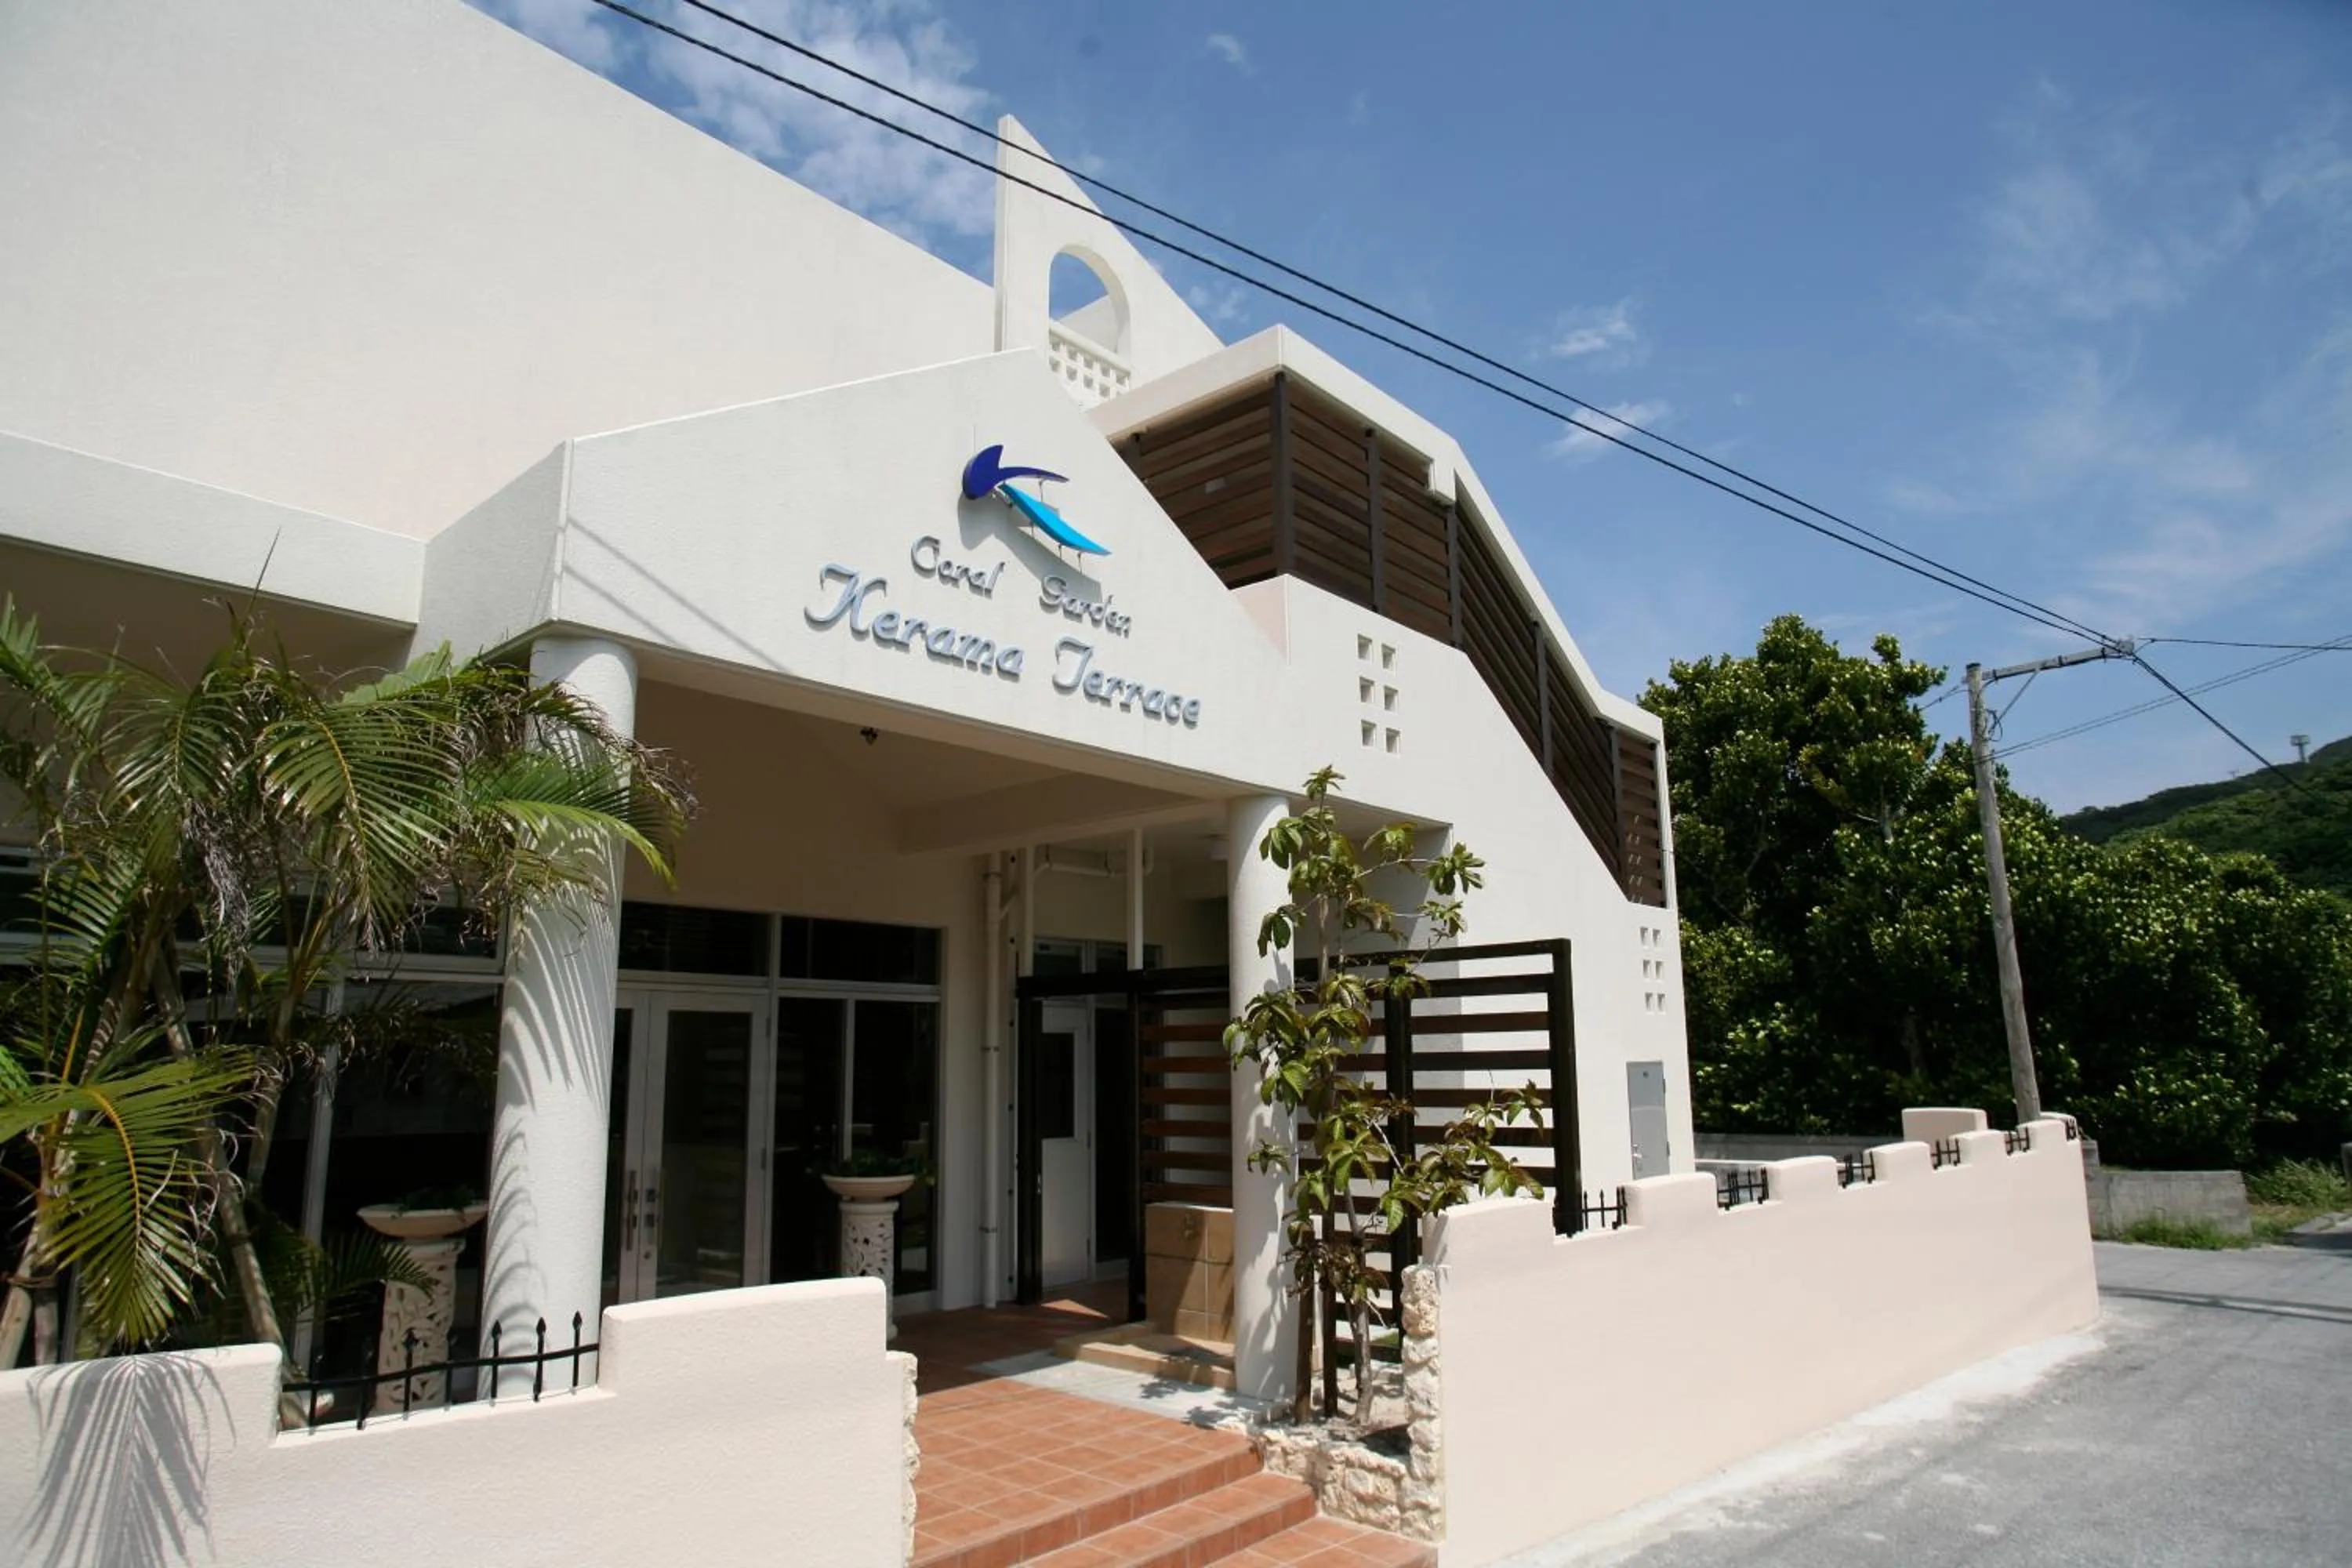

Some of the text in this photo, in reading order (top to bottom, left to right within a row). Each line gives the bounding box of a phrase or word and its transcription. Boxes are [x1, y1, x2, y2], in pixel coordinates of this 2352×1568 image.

[804, 564, 1201, 728] Kerama Terrace
[912, 536, 1131, 637] Coral Garden
